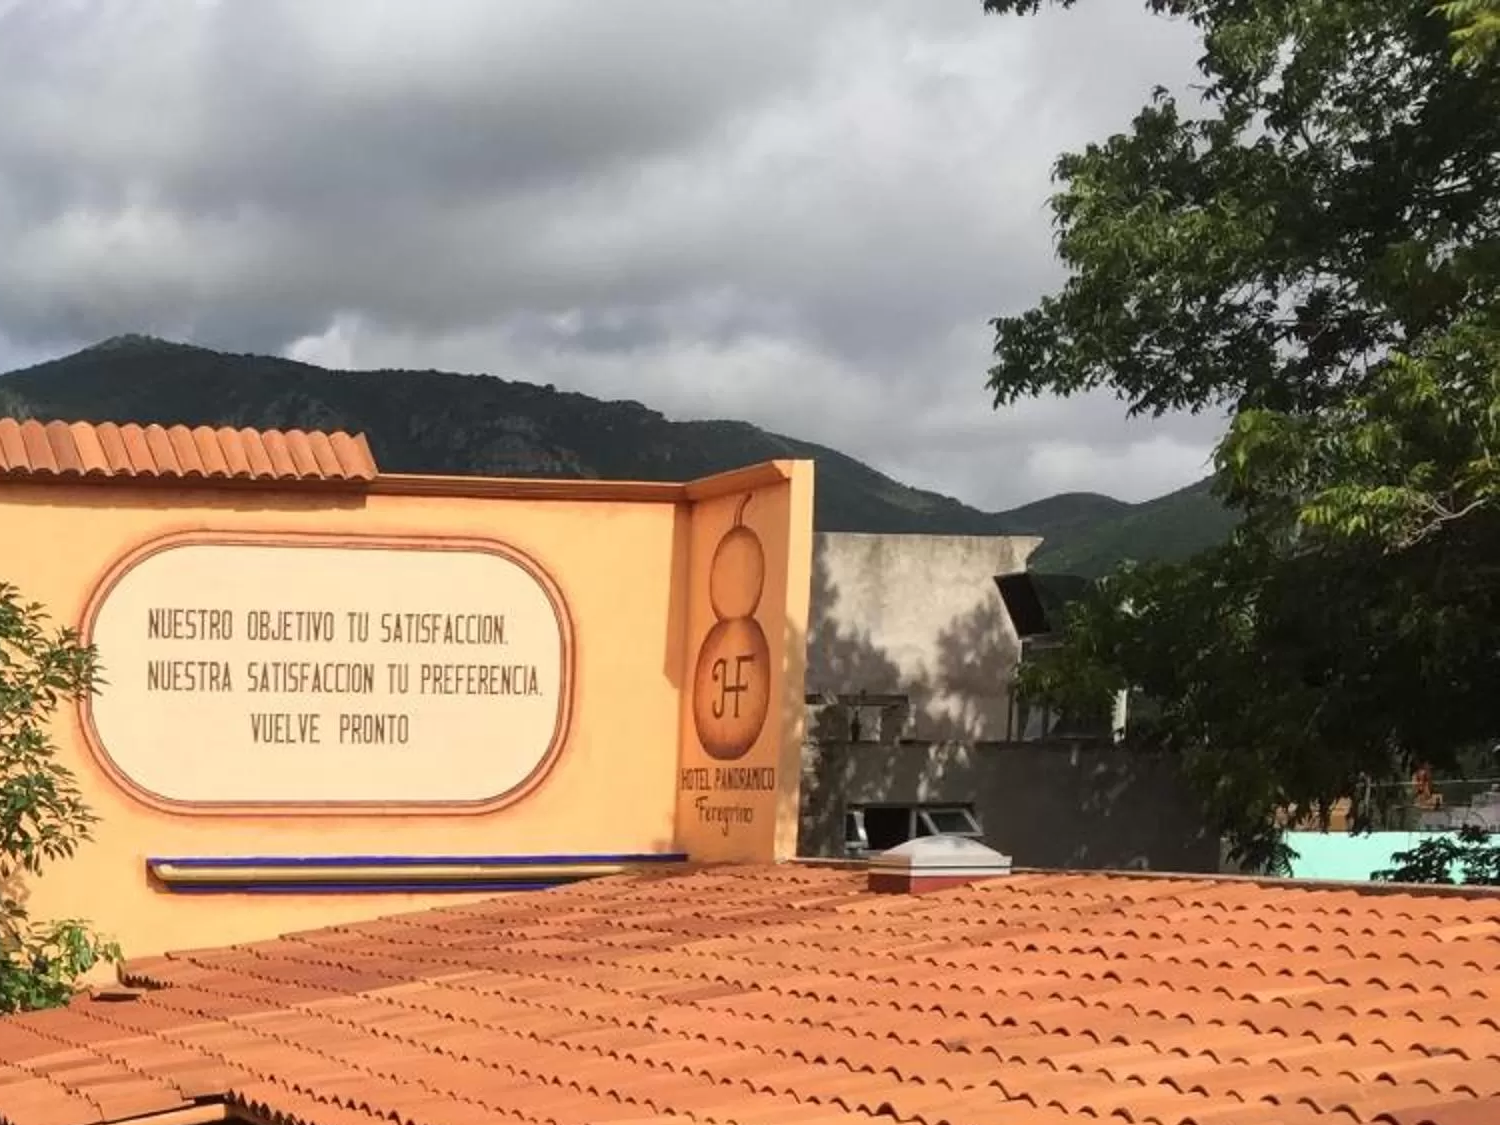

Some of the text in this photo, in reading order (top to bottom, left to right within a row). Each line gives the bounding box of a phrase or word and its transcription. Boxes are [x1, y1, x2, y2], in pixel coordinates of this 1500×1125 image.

[148, 608, 233, 641] NUESTRO
[247, 611, 335, 643] OBJETIVO
[347, 611, 369, 643] TU
[147, 660, 233, 692] NUESTRA
[247, 662, 374, 694] SATISFACCION
[387, 663, 409, 695] TU
[250, 713, 410, 745] VUELVE PRONTO
[681, 767, 711, 791] HOTEL
